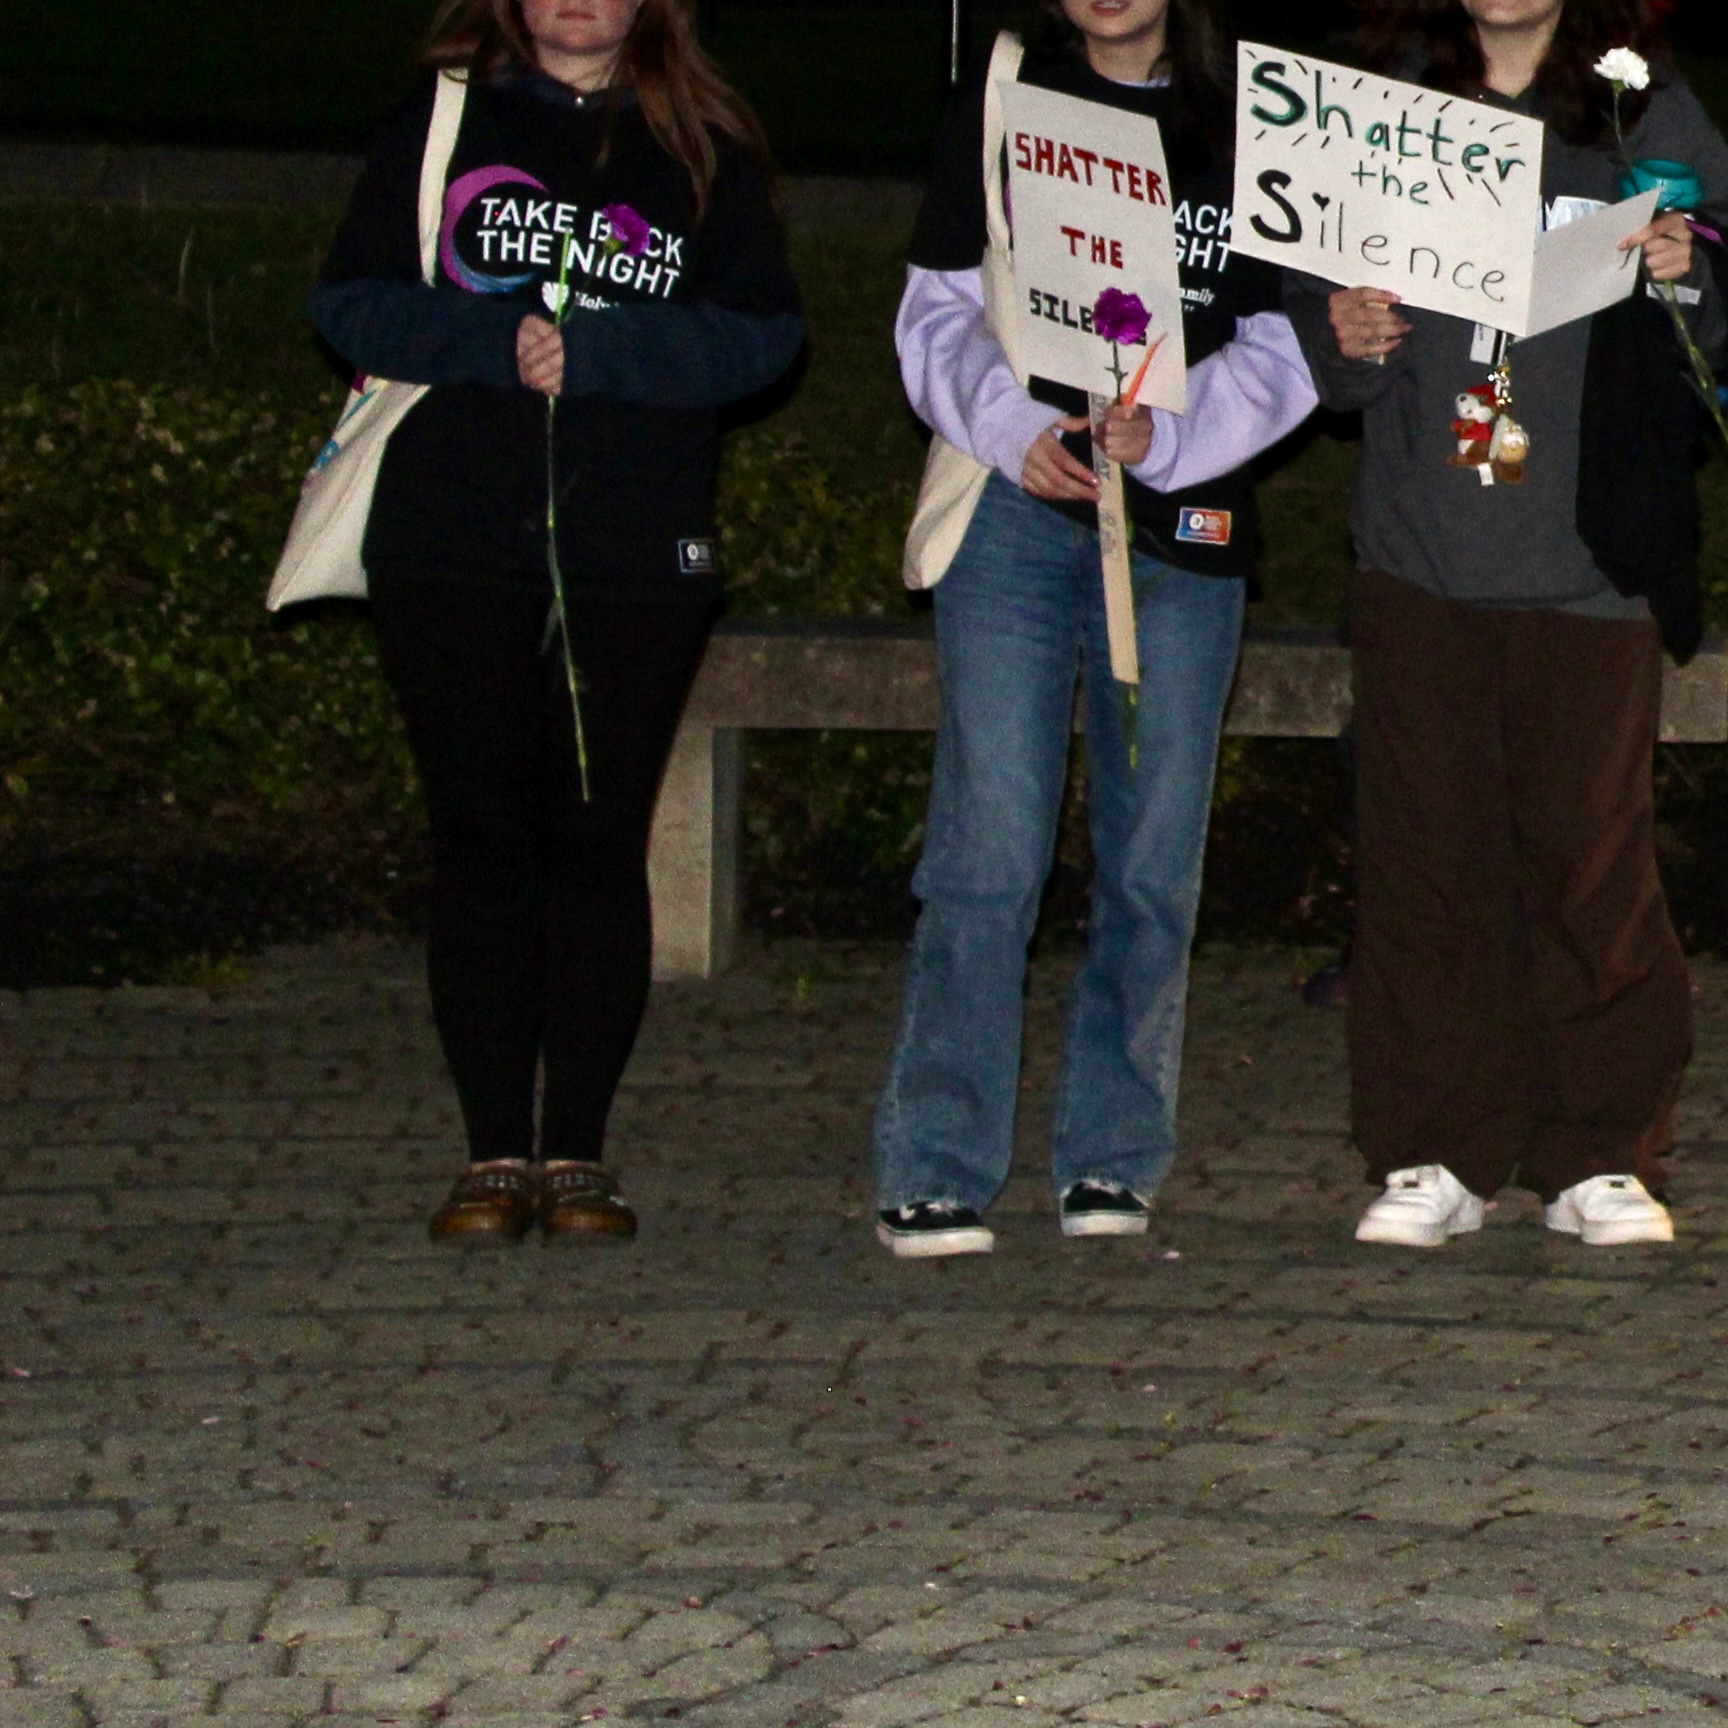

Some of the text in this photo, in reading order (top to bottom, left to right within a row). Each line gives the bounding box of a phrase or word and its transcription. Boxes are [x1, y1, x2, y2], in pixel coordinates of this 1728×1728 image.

[1250, 61, 1525, 183] Shatter
[1015, 132, 1167, 206] SHATTER
[1351, 160, 1430, 205] the
[481, 198, 684, 267] TAKE BCK
[1060, 225, 1125, 270] THE
[1173, 200, 1233, 237] ACK
[1249, 169, 1506, 302] Silence
[477, 229, 680, 298] THE NIGHT
[1175, 233, 1230, 273] GHT
[1029, 287, 1147, 346] SILE
